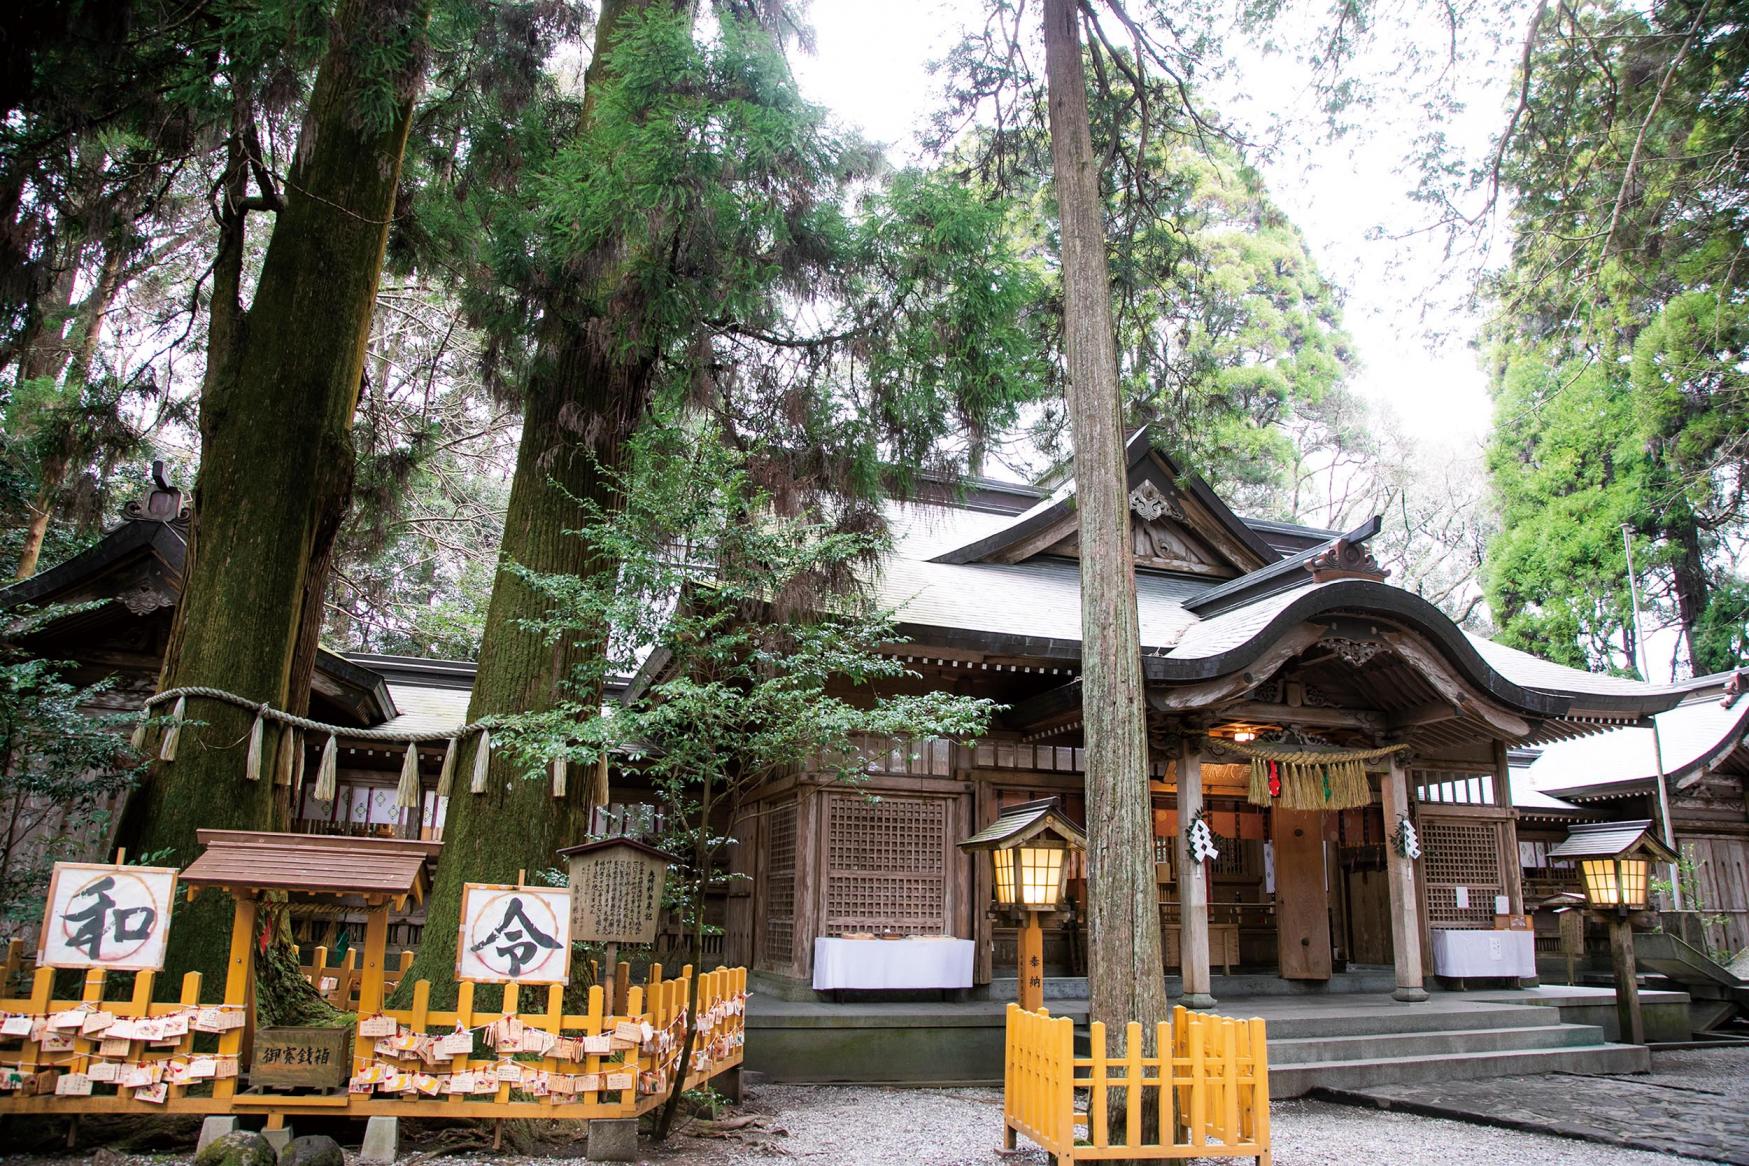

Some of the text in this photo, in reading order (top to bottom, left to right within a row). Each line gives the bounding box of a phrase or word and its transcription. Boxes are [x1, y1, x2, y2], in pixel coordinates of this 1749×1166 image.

[59, 875, 155, 960] 和
[470, 896, 564, 978] 令
[1029, 955, 1041, 989] 奉納
[262, 1045, 331, 1066] 御賽銭箱
